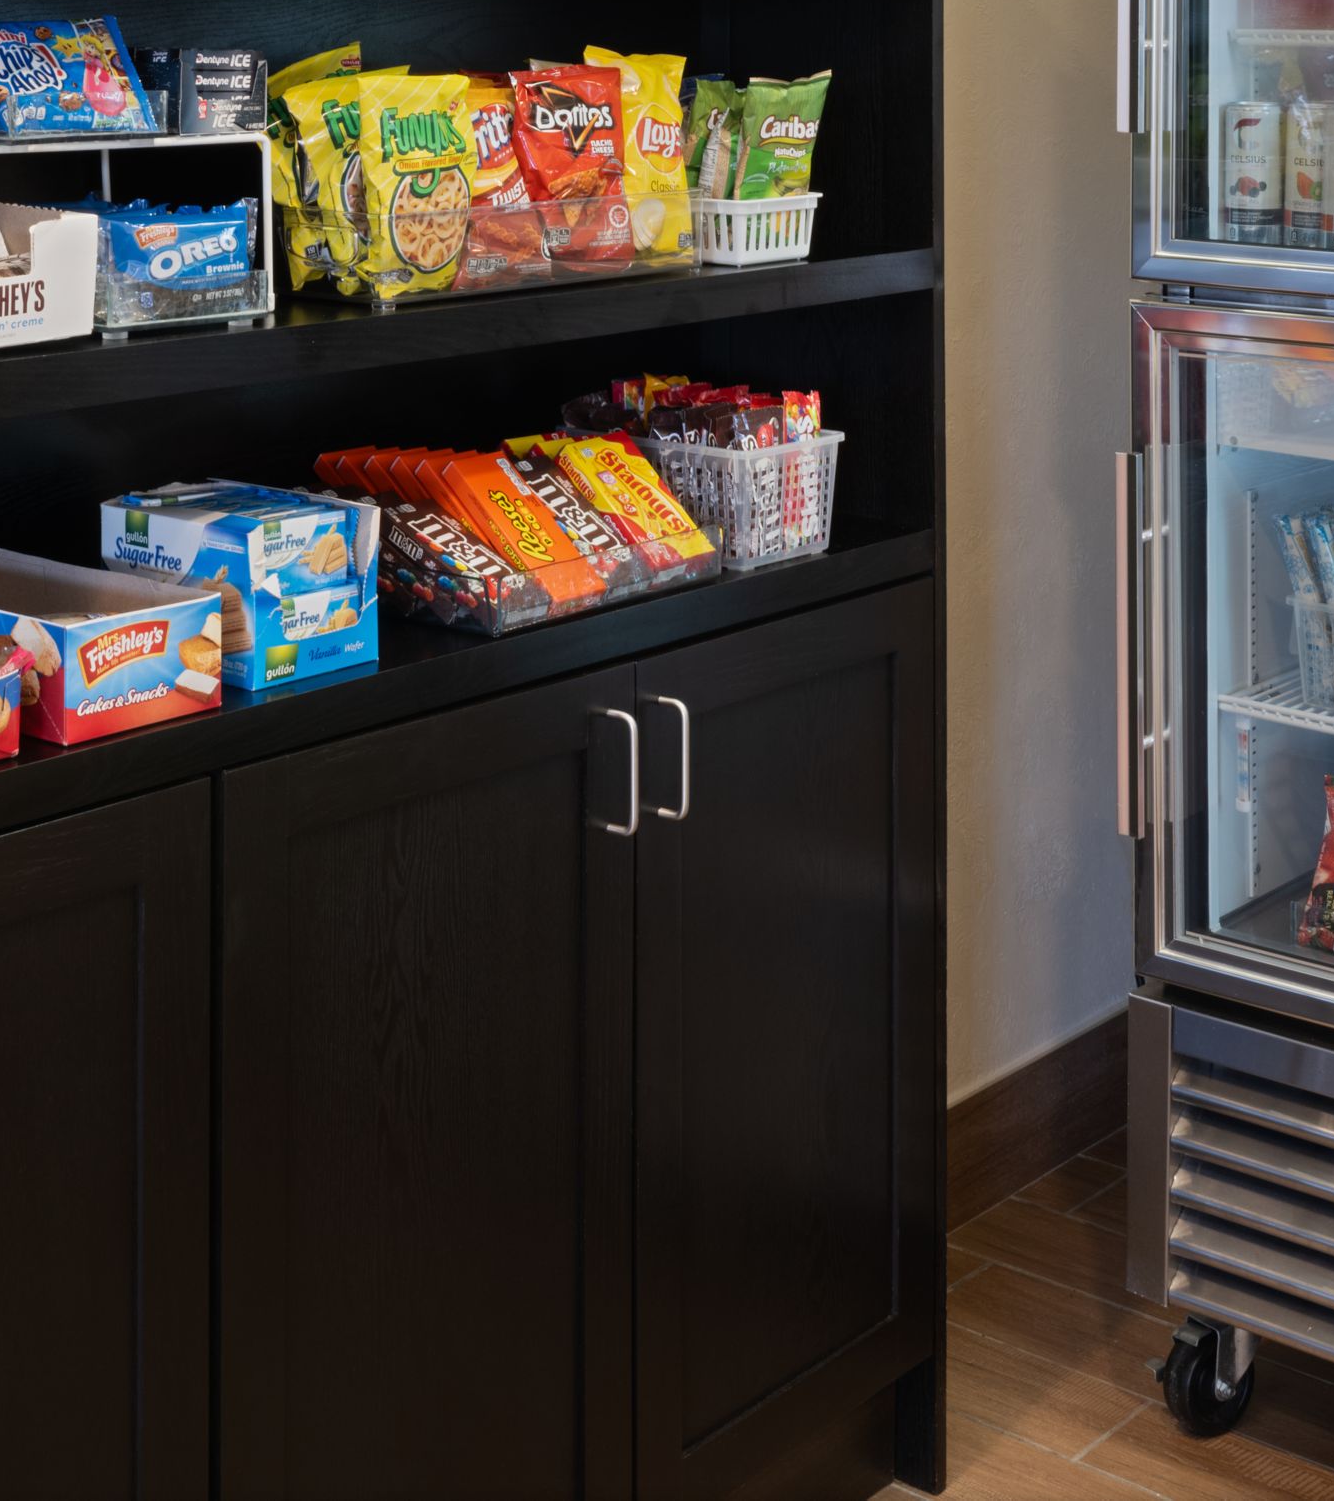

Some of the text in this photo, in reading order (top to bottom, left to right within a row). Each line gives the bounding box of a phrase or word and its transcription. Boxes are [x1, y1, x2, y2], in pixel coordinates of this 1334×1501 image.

[196, 53, 251, 67] Dentyne ICE
[195, 75, 251, 88] Dentyne ICE
[211, 102, 242, 113] Dentyne
[213, 113, 236, 128] ICE
[536, 104, 613, 130] Doritos
[591, 139, 613, 147] NACHO
[642, 117, 681, 158] Lay's
[592, 146, 614, 154] CHEESE
[399, 157, 448, 170] Onion Flavored
[1230, 155, 1266, 163] CELSIUS
[651, 180, 680, 192] Classic
[150, 228, 237, 279] OREO
[206, 262, 244, 276] Brownie
[126, 532, 148, 545] gullón
[114, 537, 182, 570] Sugar Free
[86, 626, 164, 665] Freshley's
[309, 641, 365, 662] Vanilla Wafer
[266, 664, 295, 681] gullón
[76, 684, 169, 718] Cakes & Snacks
